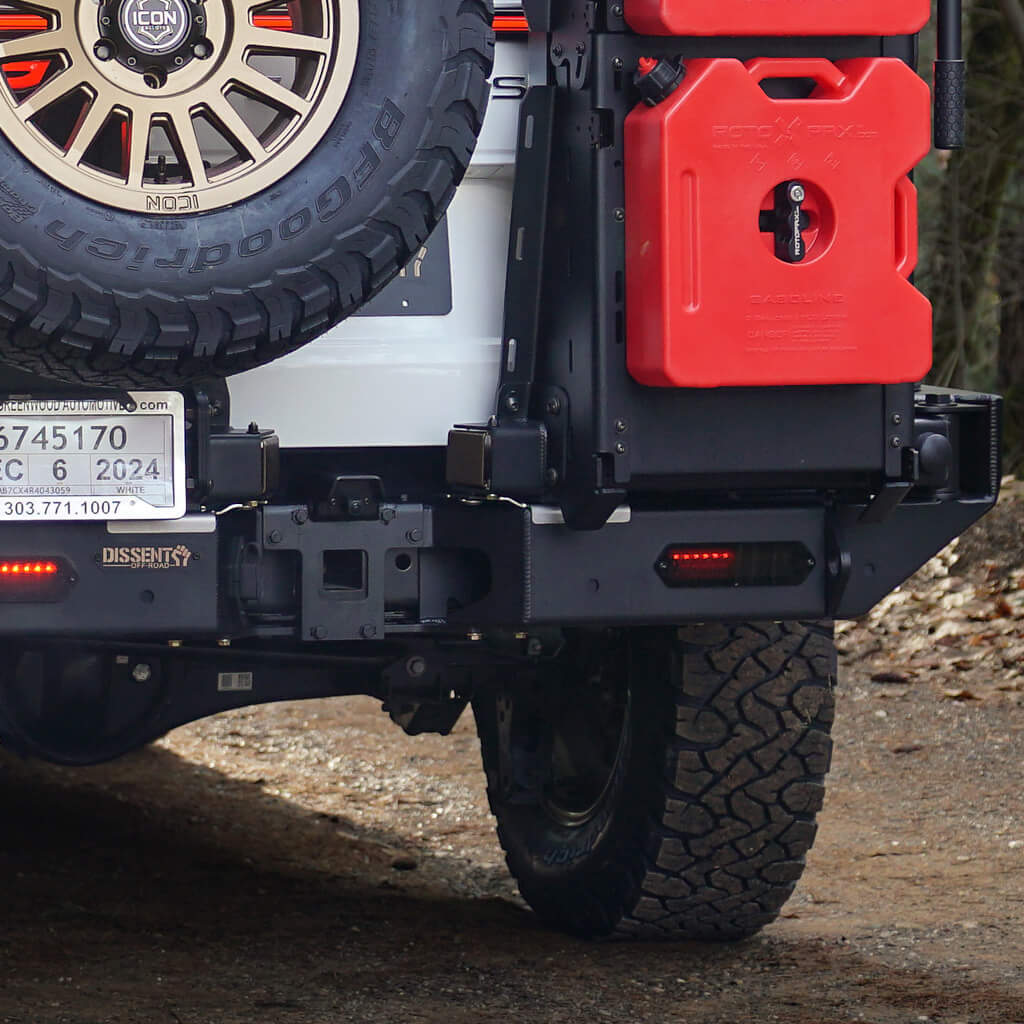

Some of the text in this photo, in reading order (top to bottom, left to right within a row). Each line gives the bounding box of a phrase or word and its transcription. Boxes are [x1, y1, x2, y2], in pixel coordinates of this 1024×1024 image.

[132, 10, 177, 26] ICON
[43, 95, 407, 274] BFGoodrich
[145, 194, 200, 211] ICON
[52, 458, 67, 481] 6
[95, 457, 160, 481] 2024
[116, 485, 145, 495] WHITE
[4, 500, 121, 516] 303.771.1007
[102, 547, 174, 563] DISSENT
